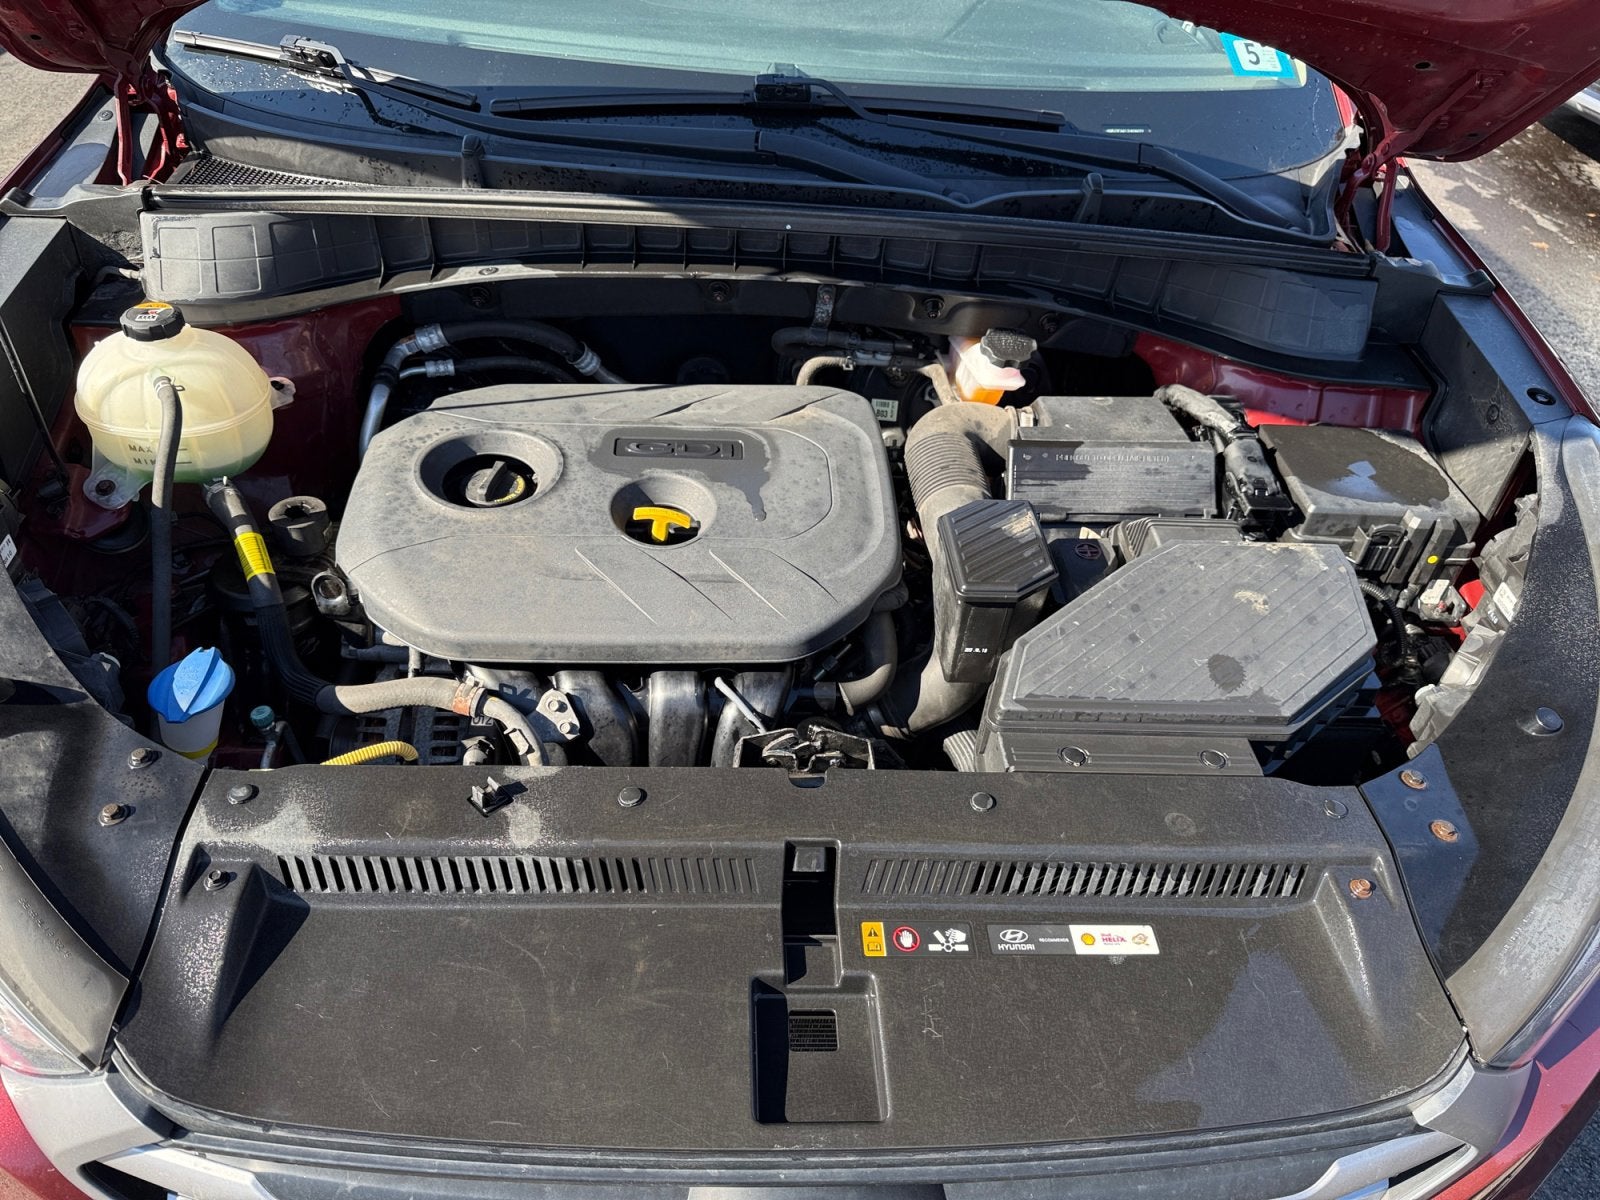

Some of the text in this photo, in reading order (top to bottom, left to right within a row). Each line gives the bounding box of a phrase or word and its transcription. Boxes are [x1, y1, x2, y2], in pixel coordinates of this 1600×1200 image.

[1243, 43, 1260, 65] 5
[128, 444, 153, 453] MAX
[625, 441, 736, 458] GDI
